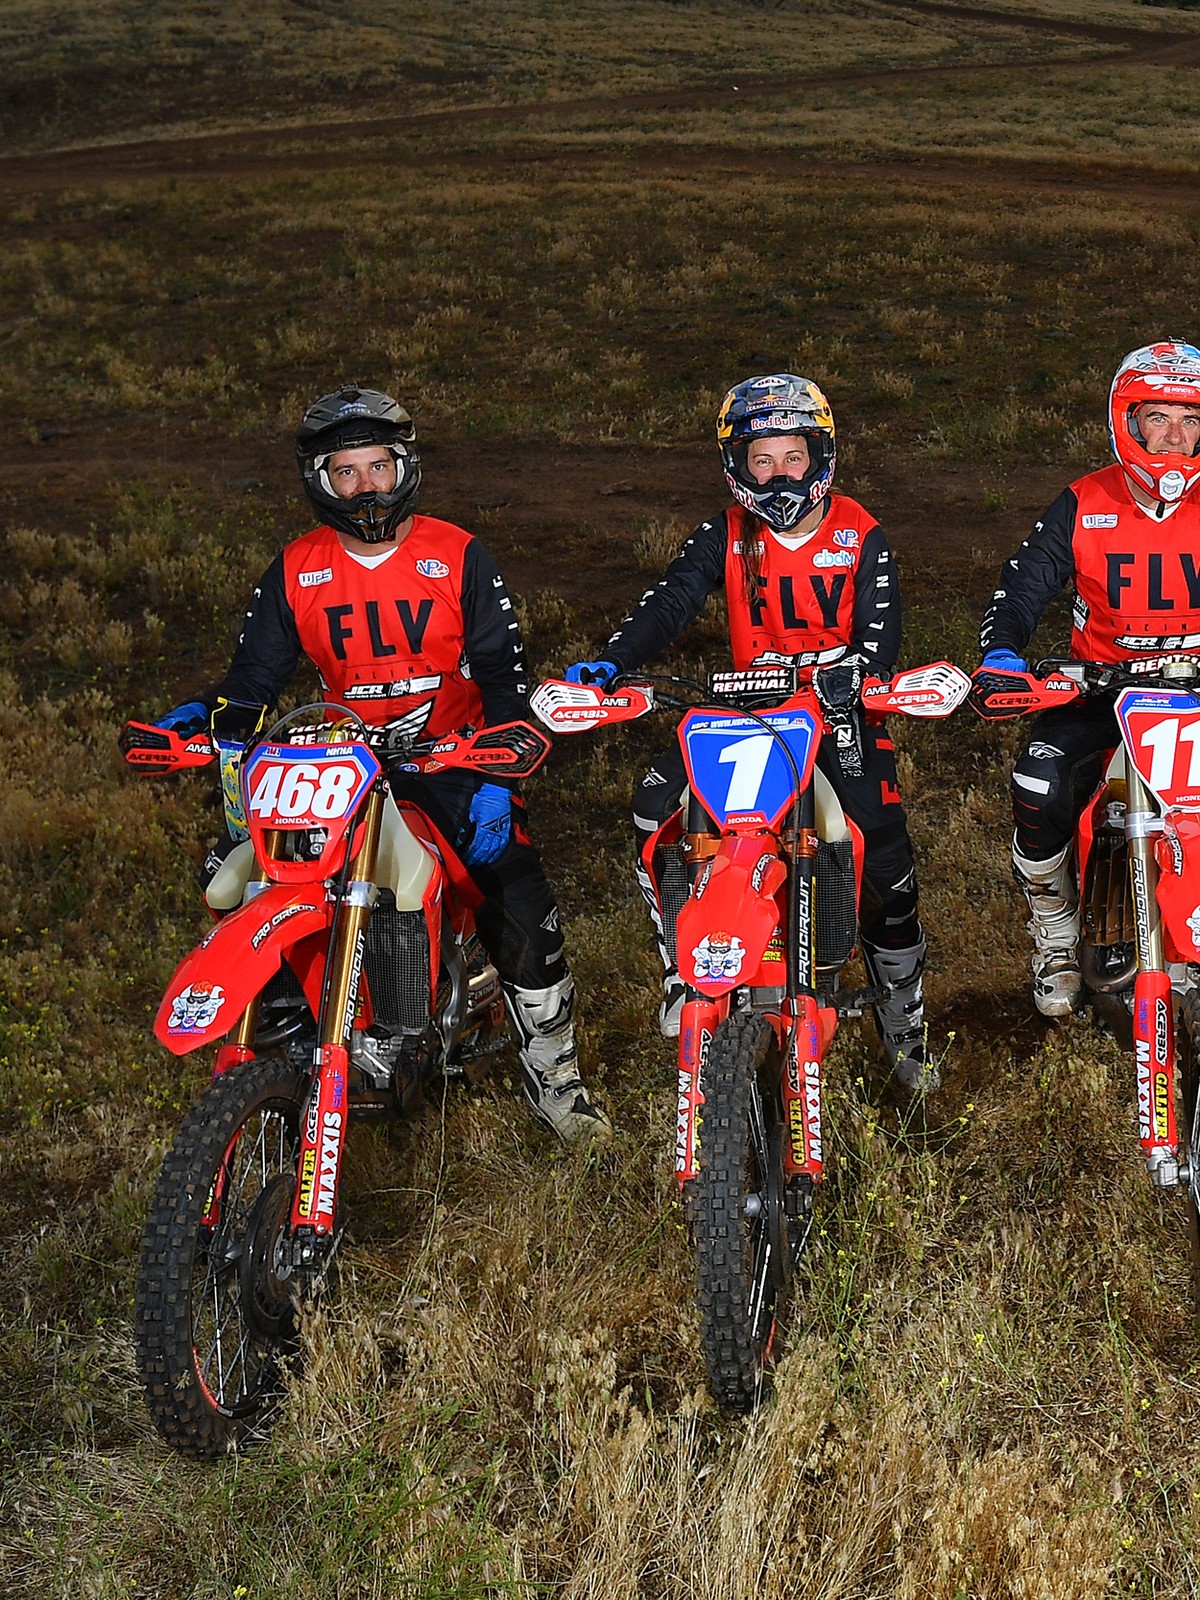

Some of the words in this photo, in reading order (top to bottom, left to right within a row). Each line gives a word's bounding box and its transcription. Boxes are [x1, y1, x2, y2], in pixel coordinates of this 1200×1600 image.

[751, 418, 773, 431] Red
[774, 415, 796, 429] Bull
[1084, 516, 1118, 527] WPS
[751, 574, 847, 630] FLY
[323, 600, 434, 660] FLY
[1117, 637, 1158, 647] JCR
[755, 652, 794, 665] JCR
[346, 685, 384, 697] JCR
[713, 678, 790, 694] RENTHAL
[864, 685, 891, 697] AME
[886, 694, 940, 705] ACERBIS
[1045, 682, 1072, 691] AME
[552, 709, 610, 719] ACERBIS
[602, 697, 630, 707] AME
[988, 697, 1041, 706] ACERBIS
[127, 752, 180, 763] ACERBIS
[185, 743, 212, 755] AME
[431, 742, 456, 754] AME
[462, 752, 515, 763] ACERBIS
[718, 735, 775, 812] 1
[250, 763, 357, 820] 468
[274, 817, 311, 826] HONDA
[727, 816, 763, 825] HONDA
[751, 867, 764, 892] PRO
[1133, 857, 1147, 893] PRO
[799, 876, 813, 942] CIRCUIT
[251, 922, 271, 950] PRO
[270, 904, 318, 928] CIRCUIT
[1136, 894, 1151, 966] CIRCUIT
[346, 929, 367, 993] CIRCUIT
[798, 943, 813, 987] PRO
[342, 990, 356, 1041] PRO
[1155, 998, 1168, 1067] ACERBIS
[1135, 1038, 1152, 1140] MAXXIS
[675, 1069, 693, 1173] MAXXIS
[803, 1060, 824, 1162] MAXXIS
[1154, 1072, 1169, 1140] GALFER
[788, 1098, 807, 1165] GALFER
[316, 1110, 343, 1216] MAXXIS
[299, 1148, 317, 1217] GALFER
